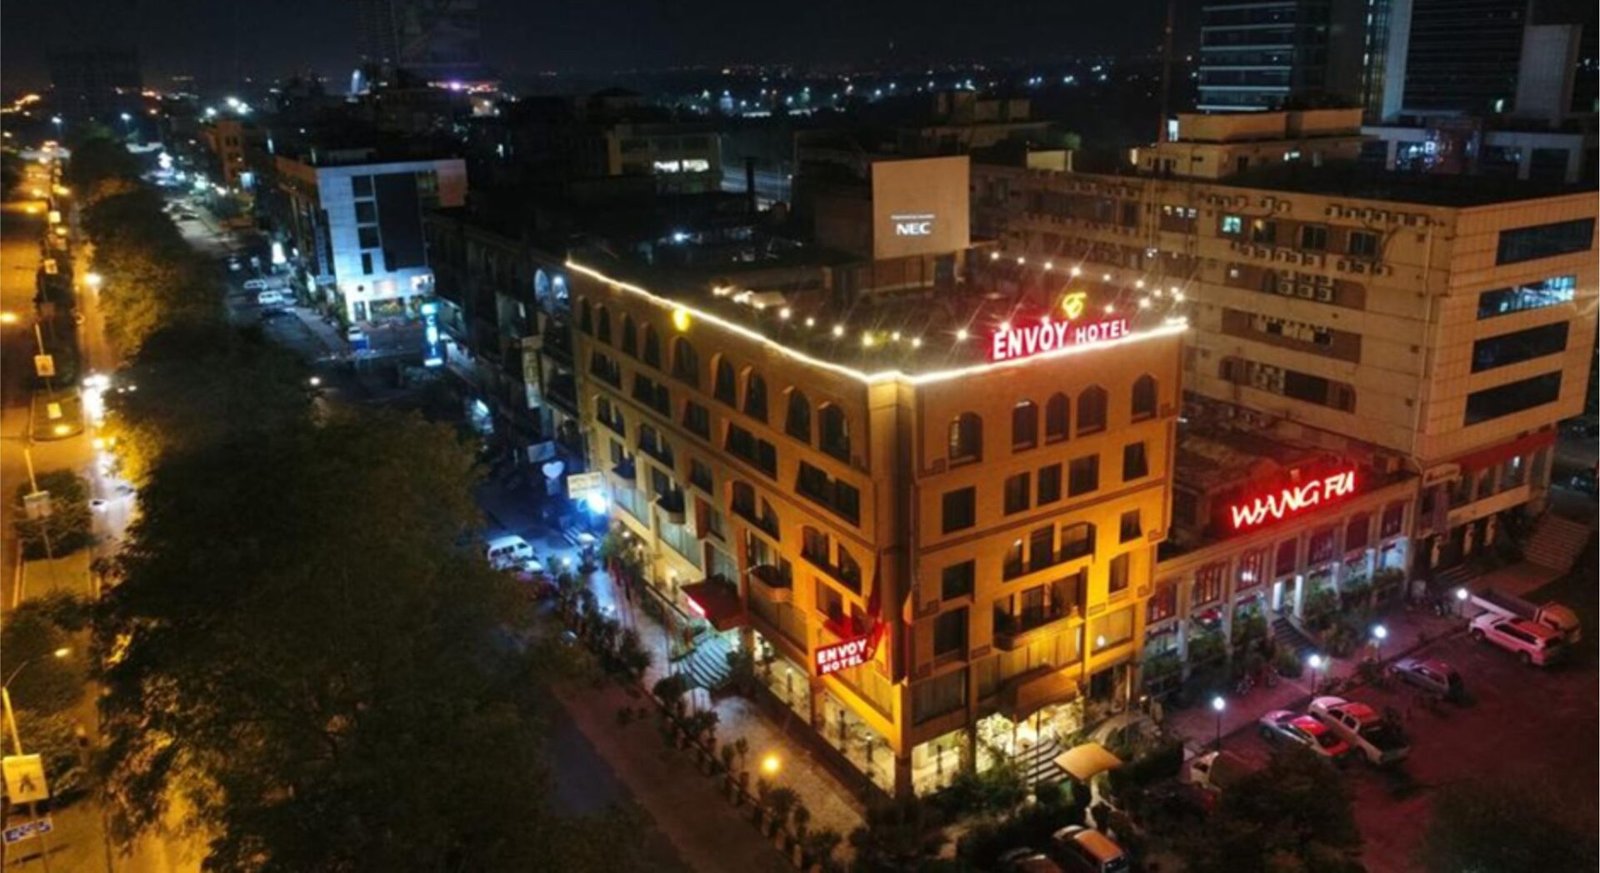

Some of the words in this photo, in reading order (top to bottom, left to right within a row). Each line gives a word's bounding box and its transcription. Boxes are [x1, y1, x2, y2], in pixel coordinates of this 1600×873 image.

[896, 222, 931, 235] NEC
[993, 321, 1068, 360] ENVOY
[1075, 319, 1129, 344] HOTEL
[1231, 480, 1321, 528] WANG
[1324, 471, 1354, 499] FU
[817, 638, 867, 665] ENVOY
[822, 654, 864, 674] HOTEL
